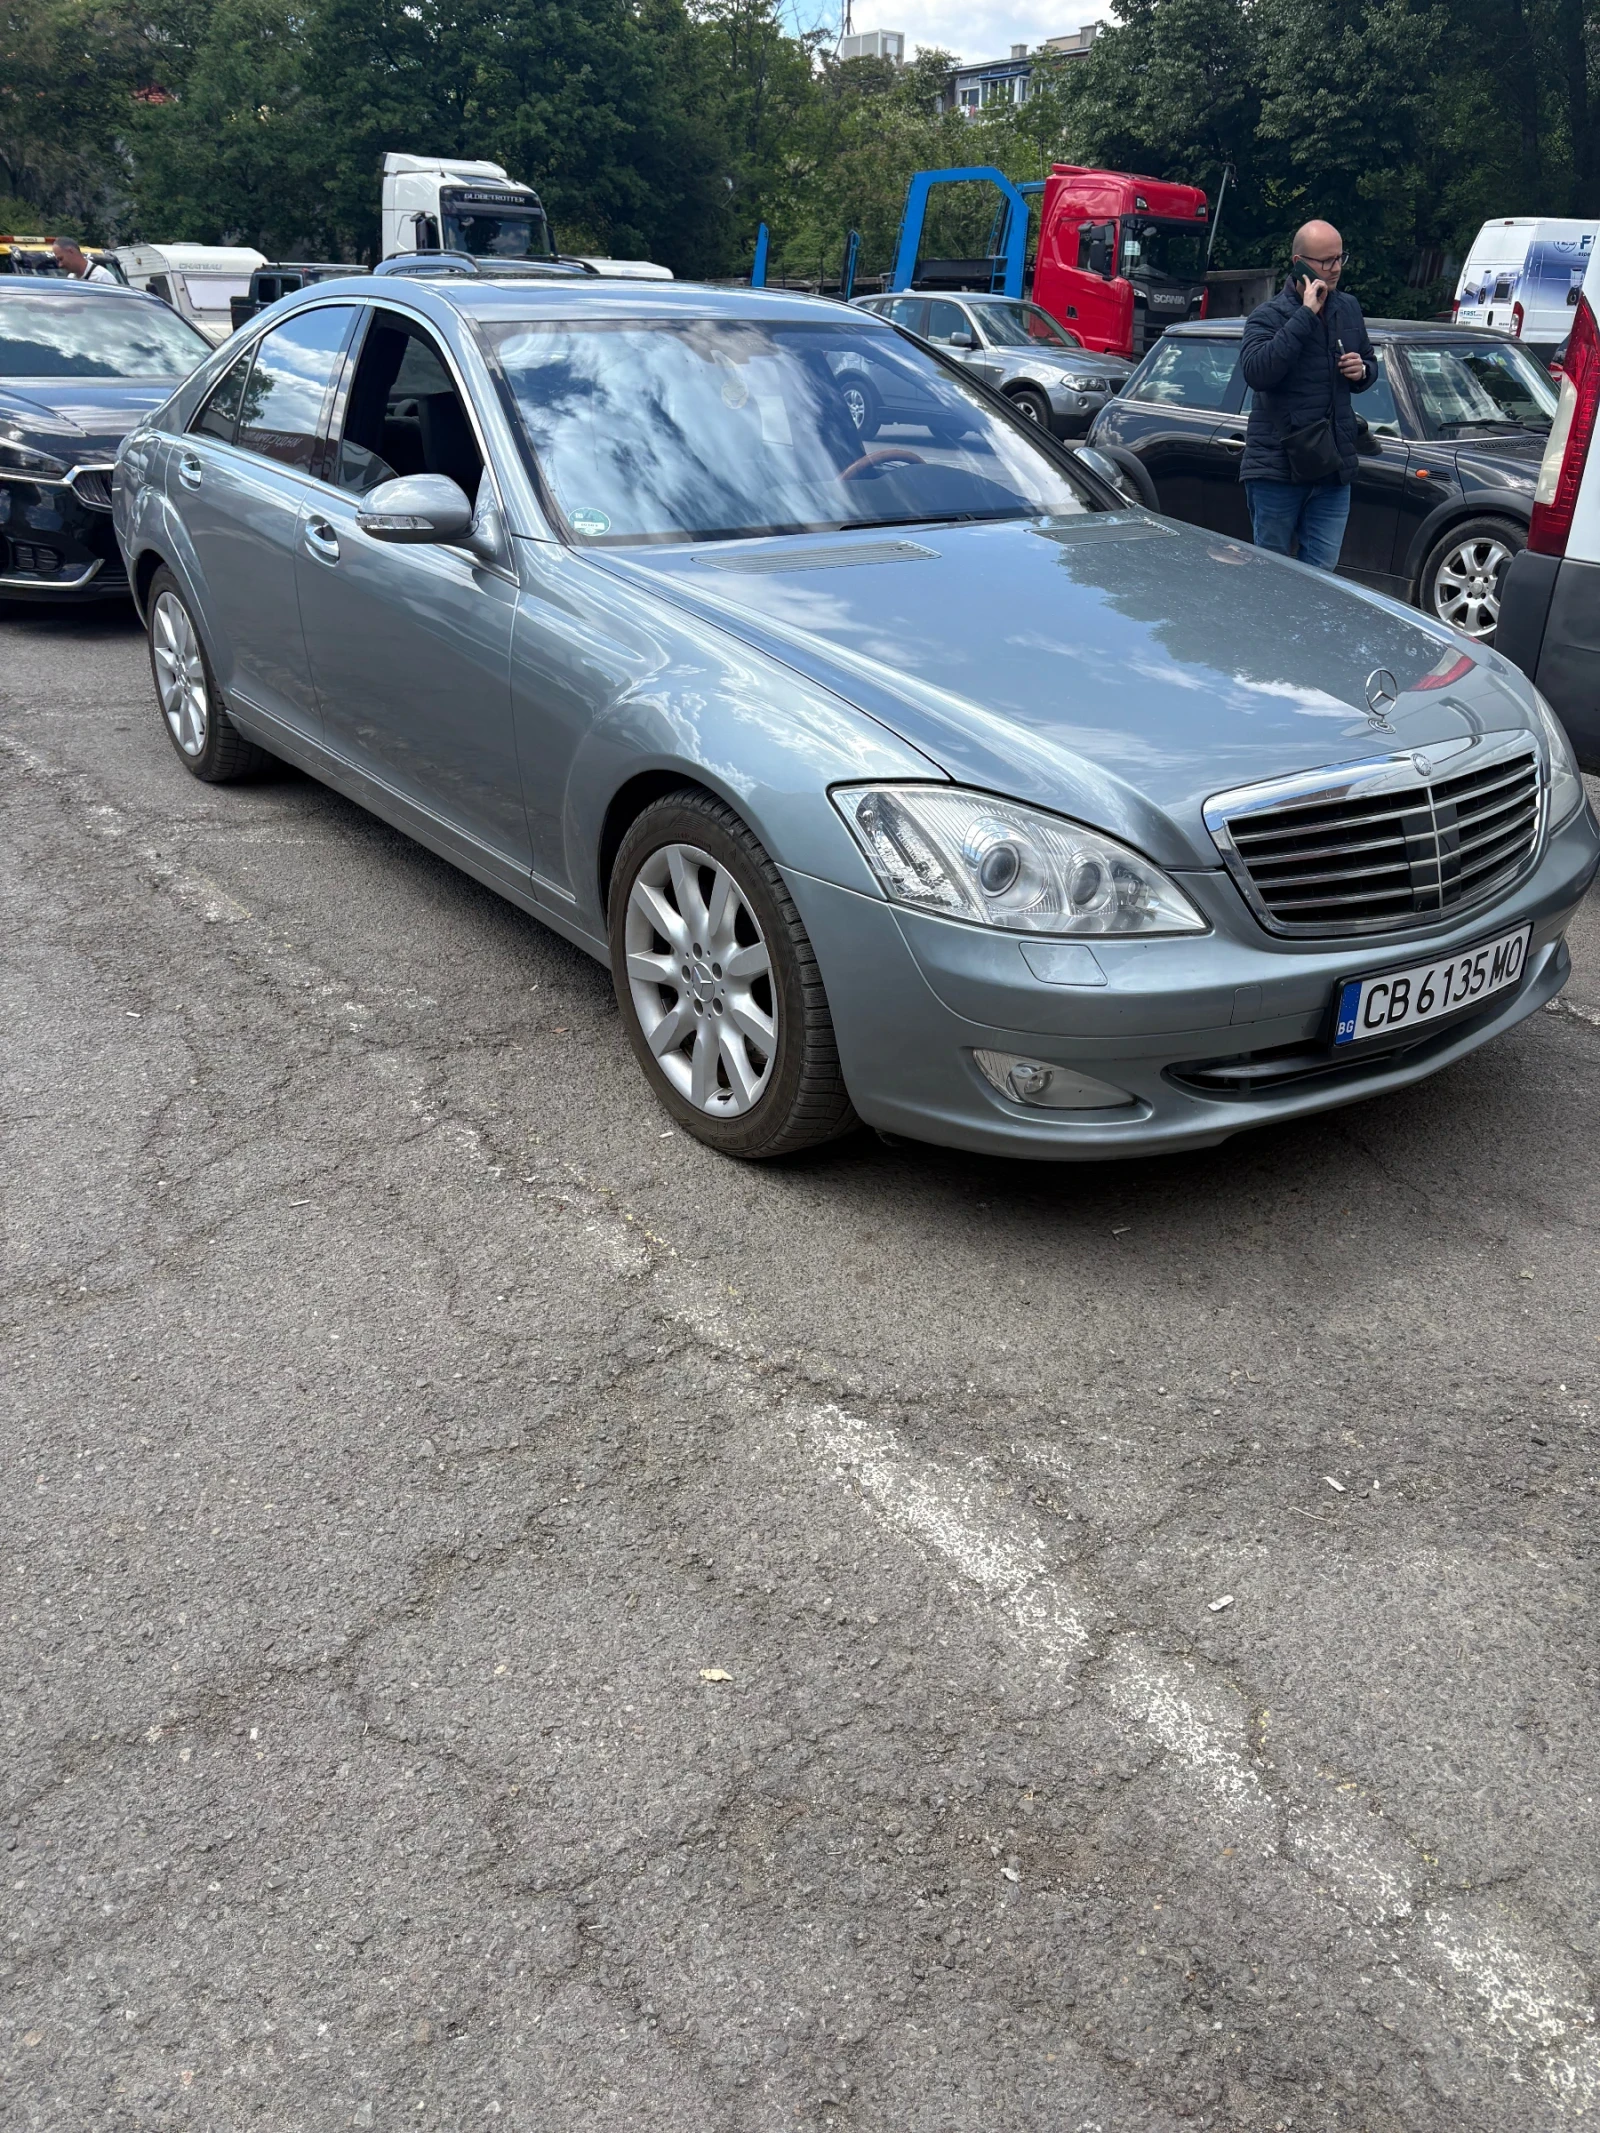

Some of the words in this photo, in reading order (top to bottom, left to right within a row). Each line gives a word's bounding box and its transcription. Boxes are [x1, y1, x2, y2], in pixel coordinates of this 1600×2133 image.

[1153, 294, 1185, 305] SCANIA
[1364, 978, 1411, 1029] CB
[1416, 951, 1489, 1014] 6135
[1489, 936, 1523, 987] MO
[1337, 1019, 1354, 1036] BG
